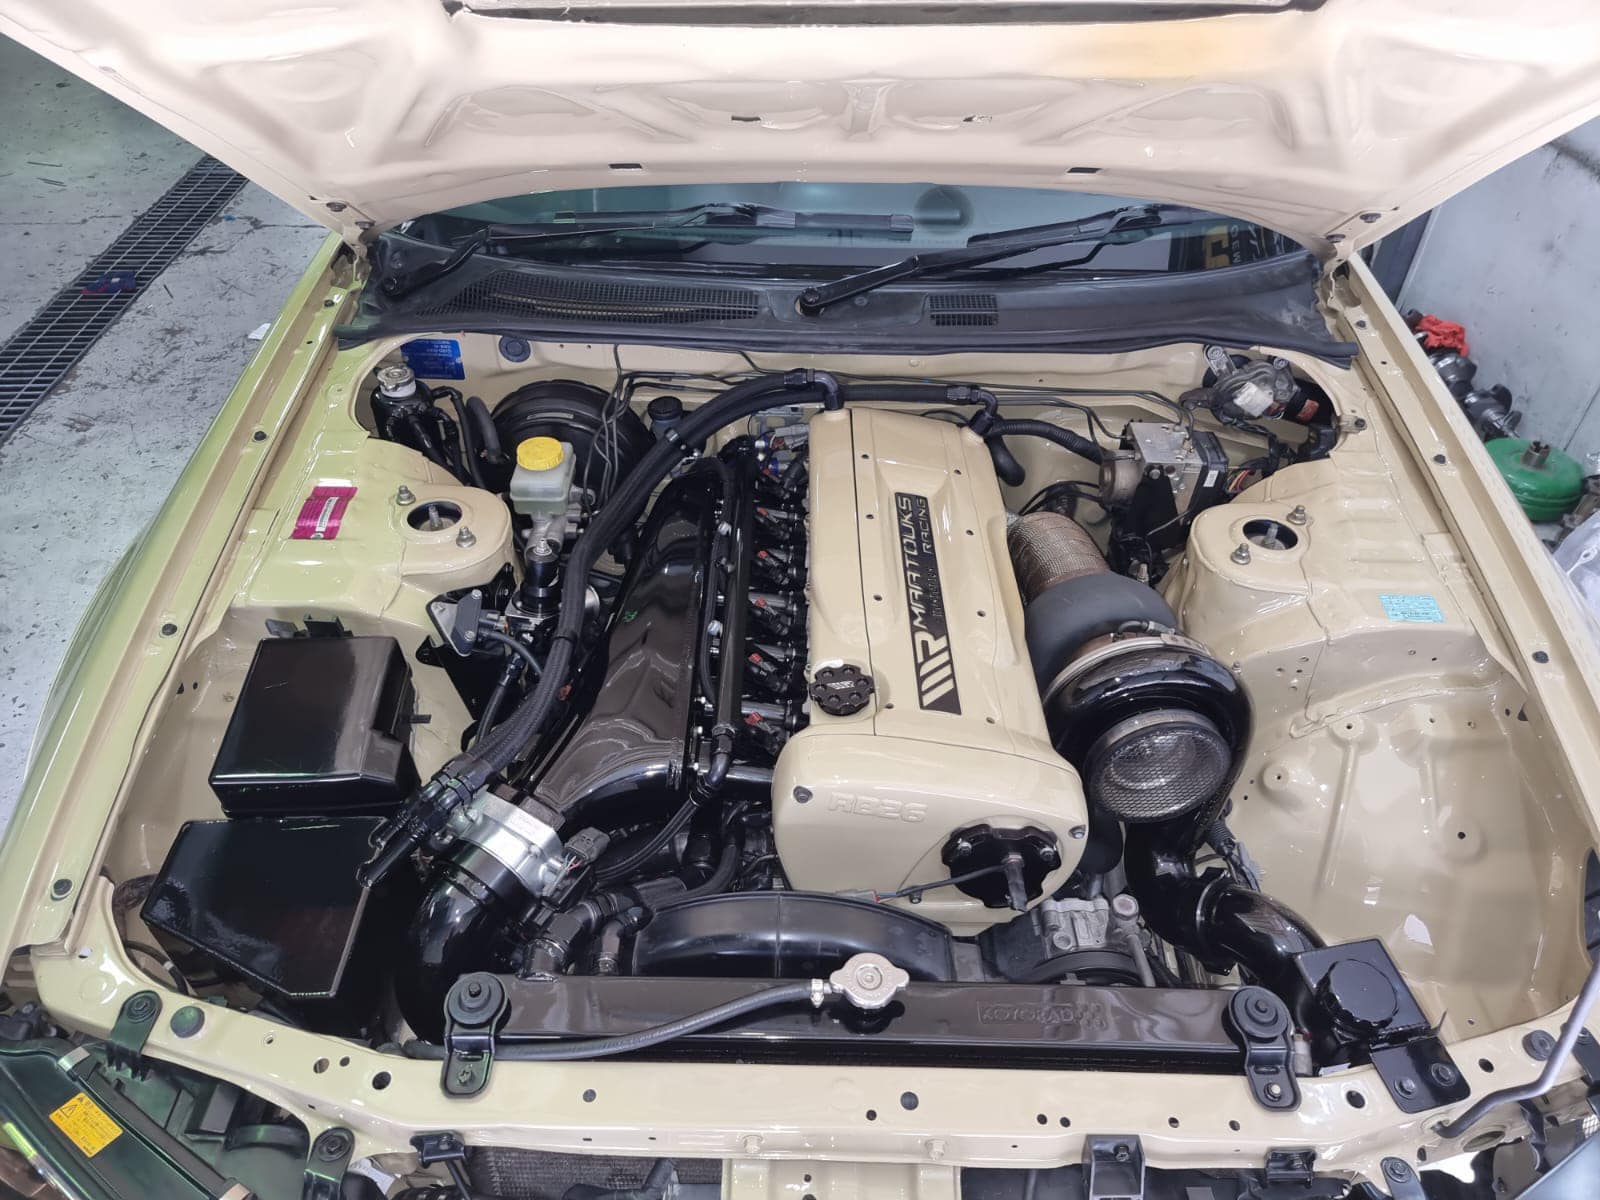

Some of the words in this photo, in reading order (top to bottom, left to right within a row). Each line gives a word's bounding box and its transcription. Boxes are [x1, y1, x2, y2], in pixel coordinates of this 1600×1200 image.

[916, 497, 932, 554] RACING
[898, 495, 927, 630] MAATOUKS
[827, 792, 928, 823] RB26
